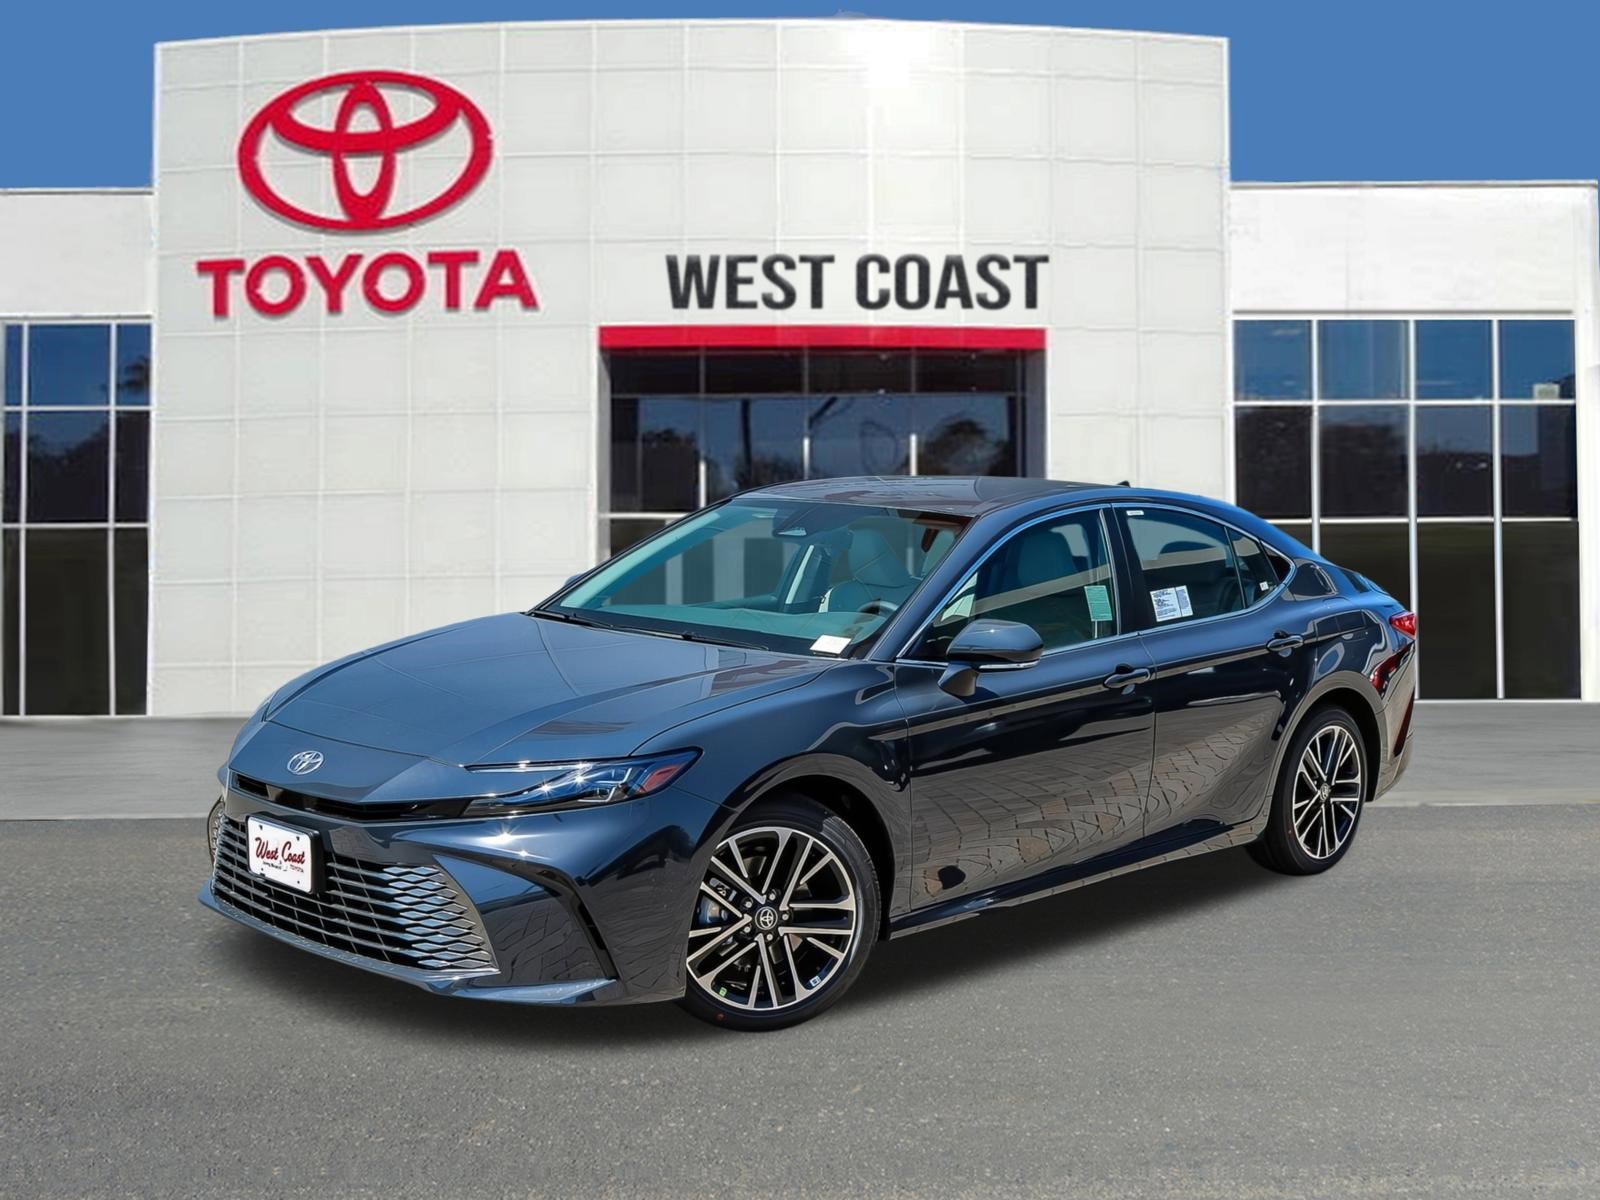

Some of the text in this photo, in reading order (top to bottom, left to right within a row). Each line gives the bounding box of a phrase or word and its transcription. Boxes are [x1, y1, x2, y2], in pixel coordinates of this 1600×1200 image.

[196, 248, 538, 317] TOYOTA
[666, 254, 1049, 310] WEST COAST
[255, 837, 305, 865] West Coast
